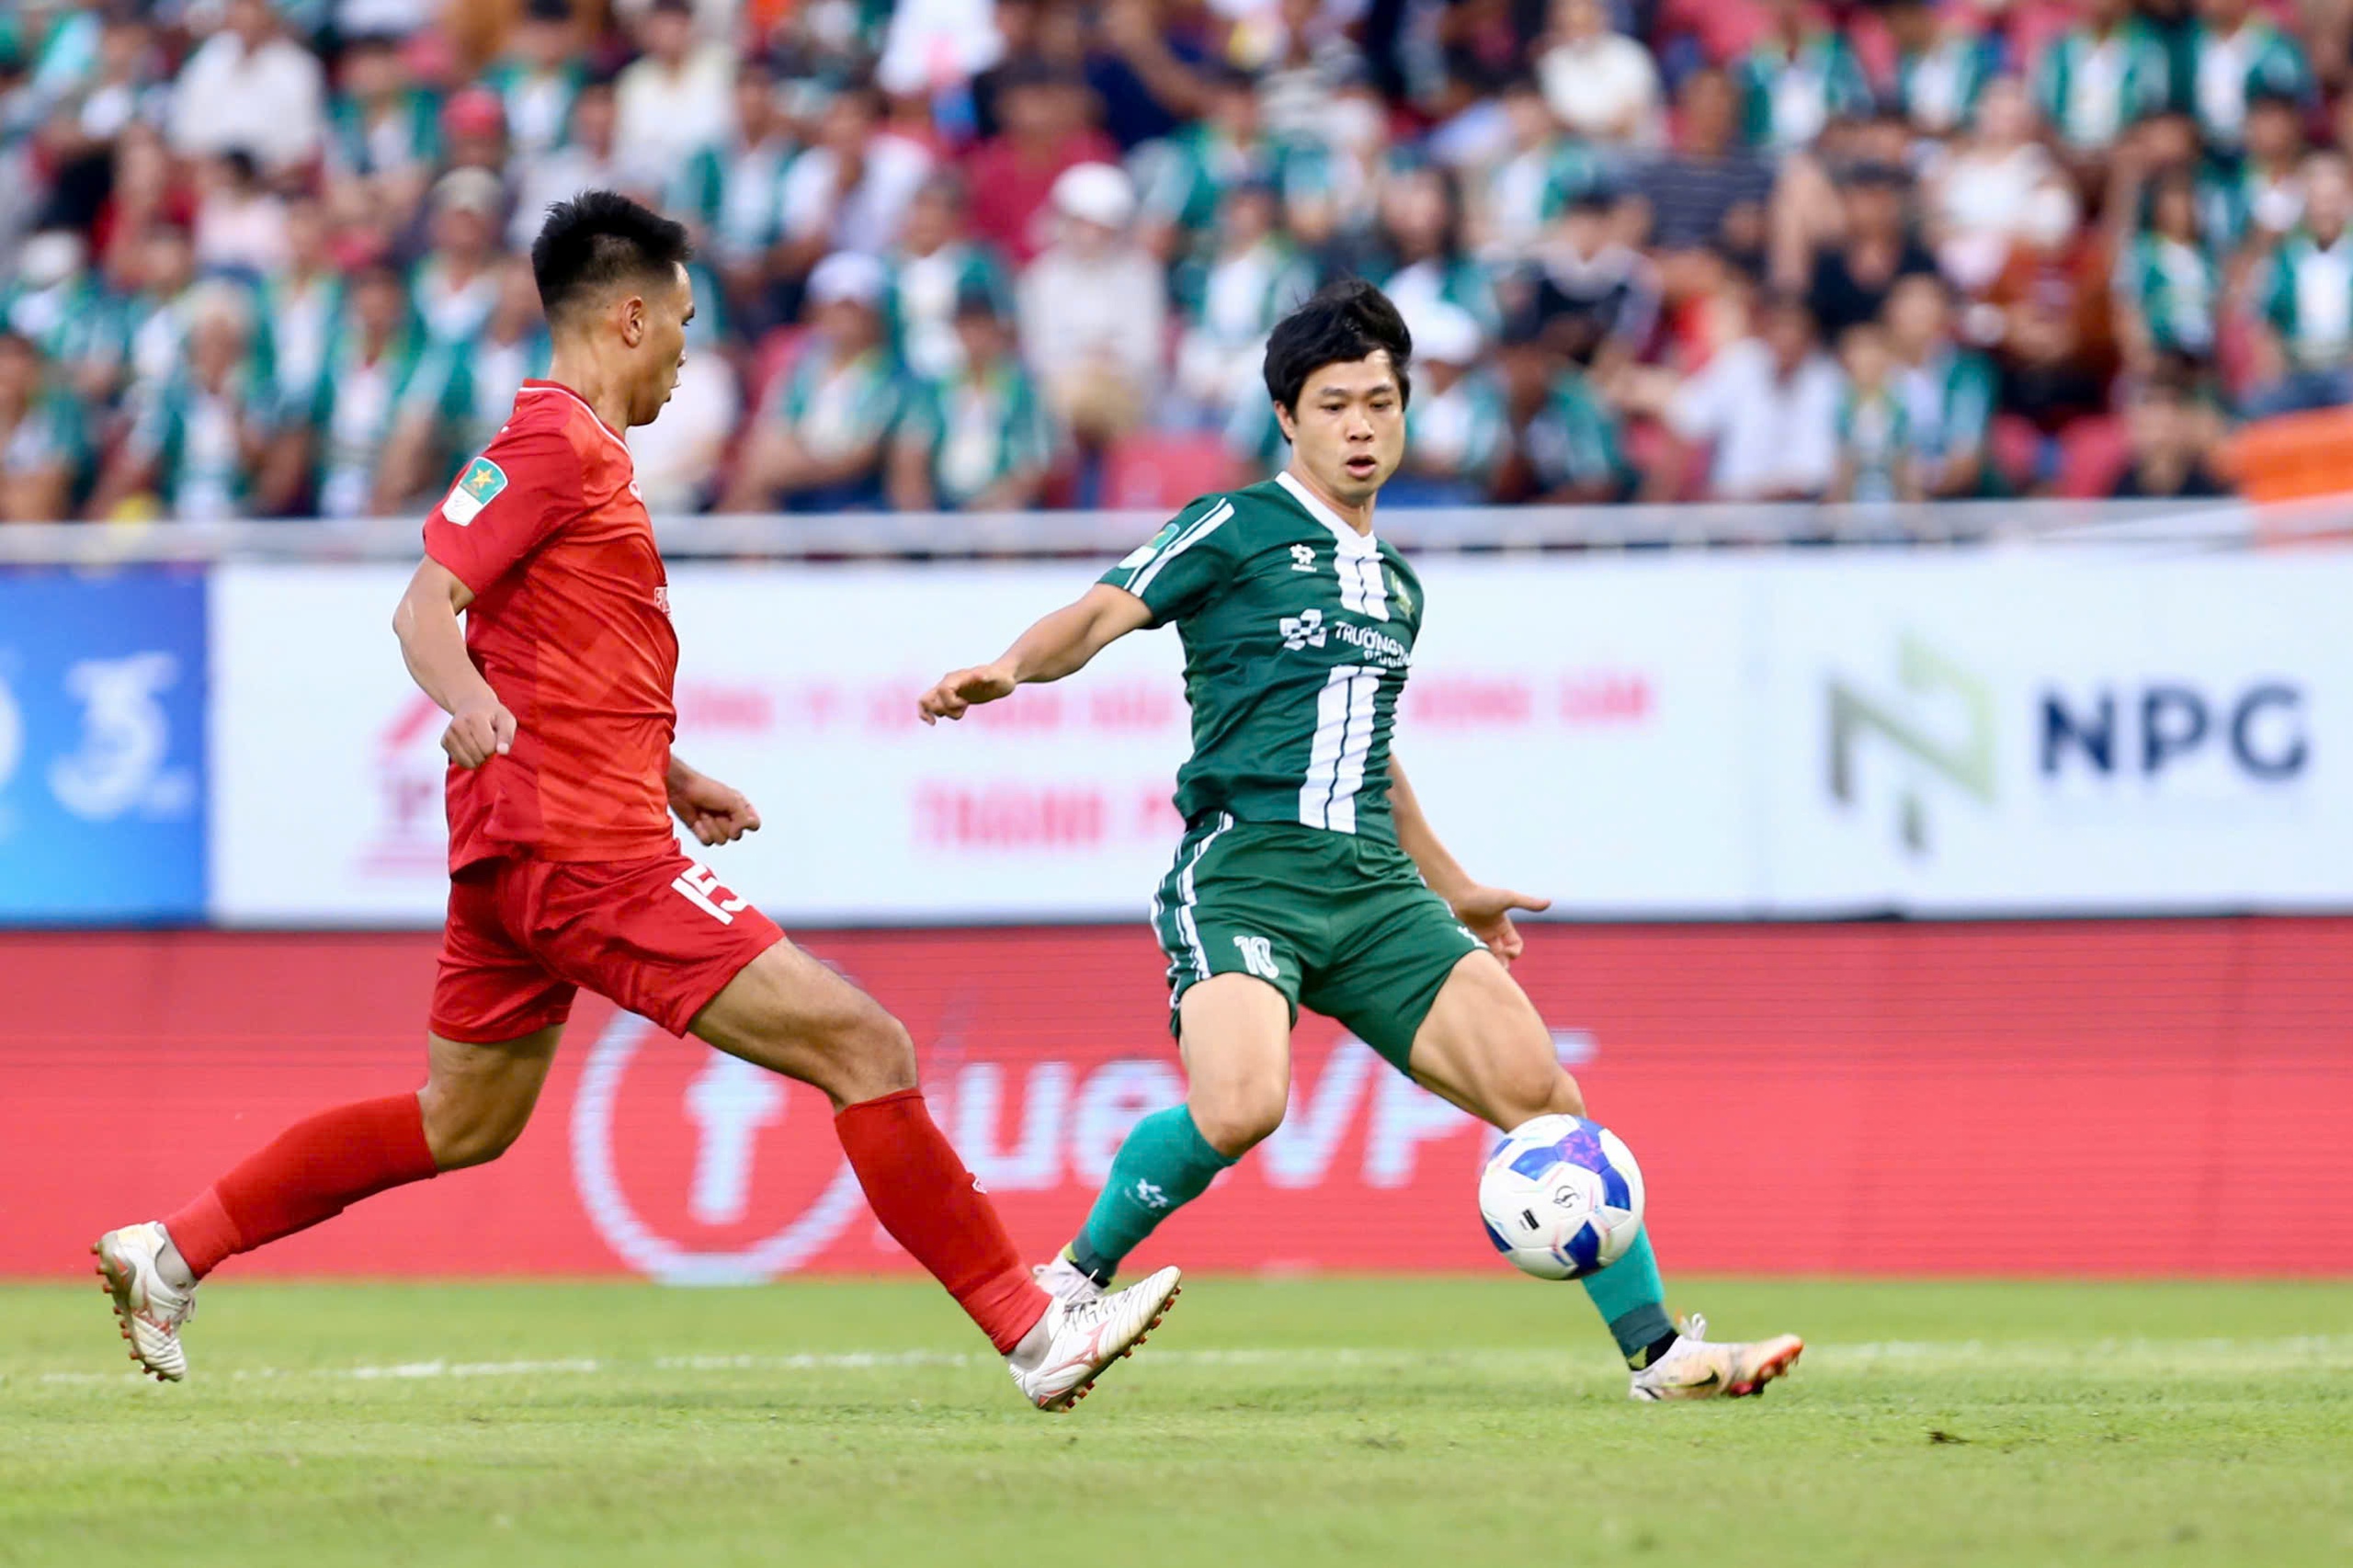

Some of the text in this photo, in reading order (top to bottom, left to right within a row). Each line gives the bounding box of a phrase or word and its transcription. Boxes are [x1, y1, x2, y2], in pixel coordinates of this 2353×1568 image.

[2035, 681, 2312, 783] NPG
[670, 862, 751, 926] 15
[1233, 935, 1279, 980] 10
